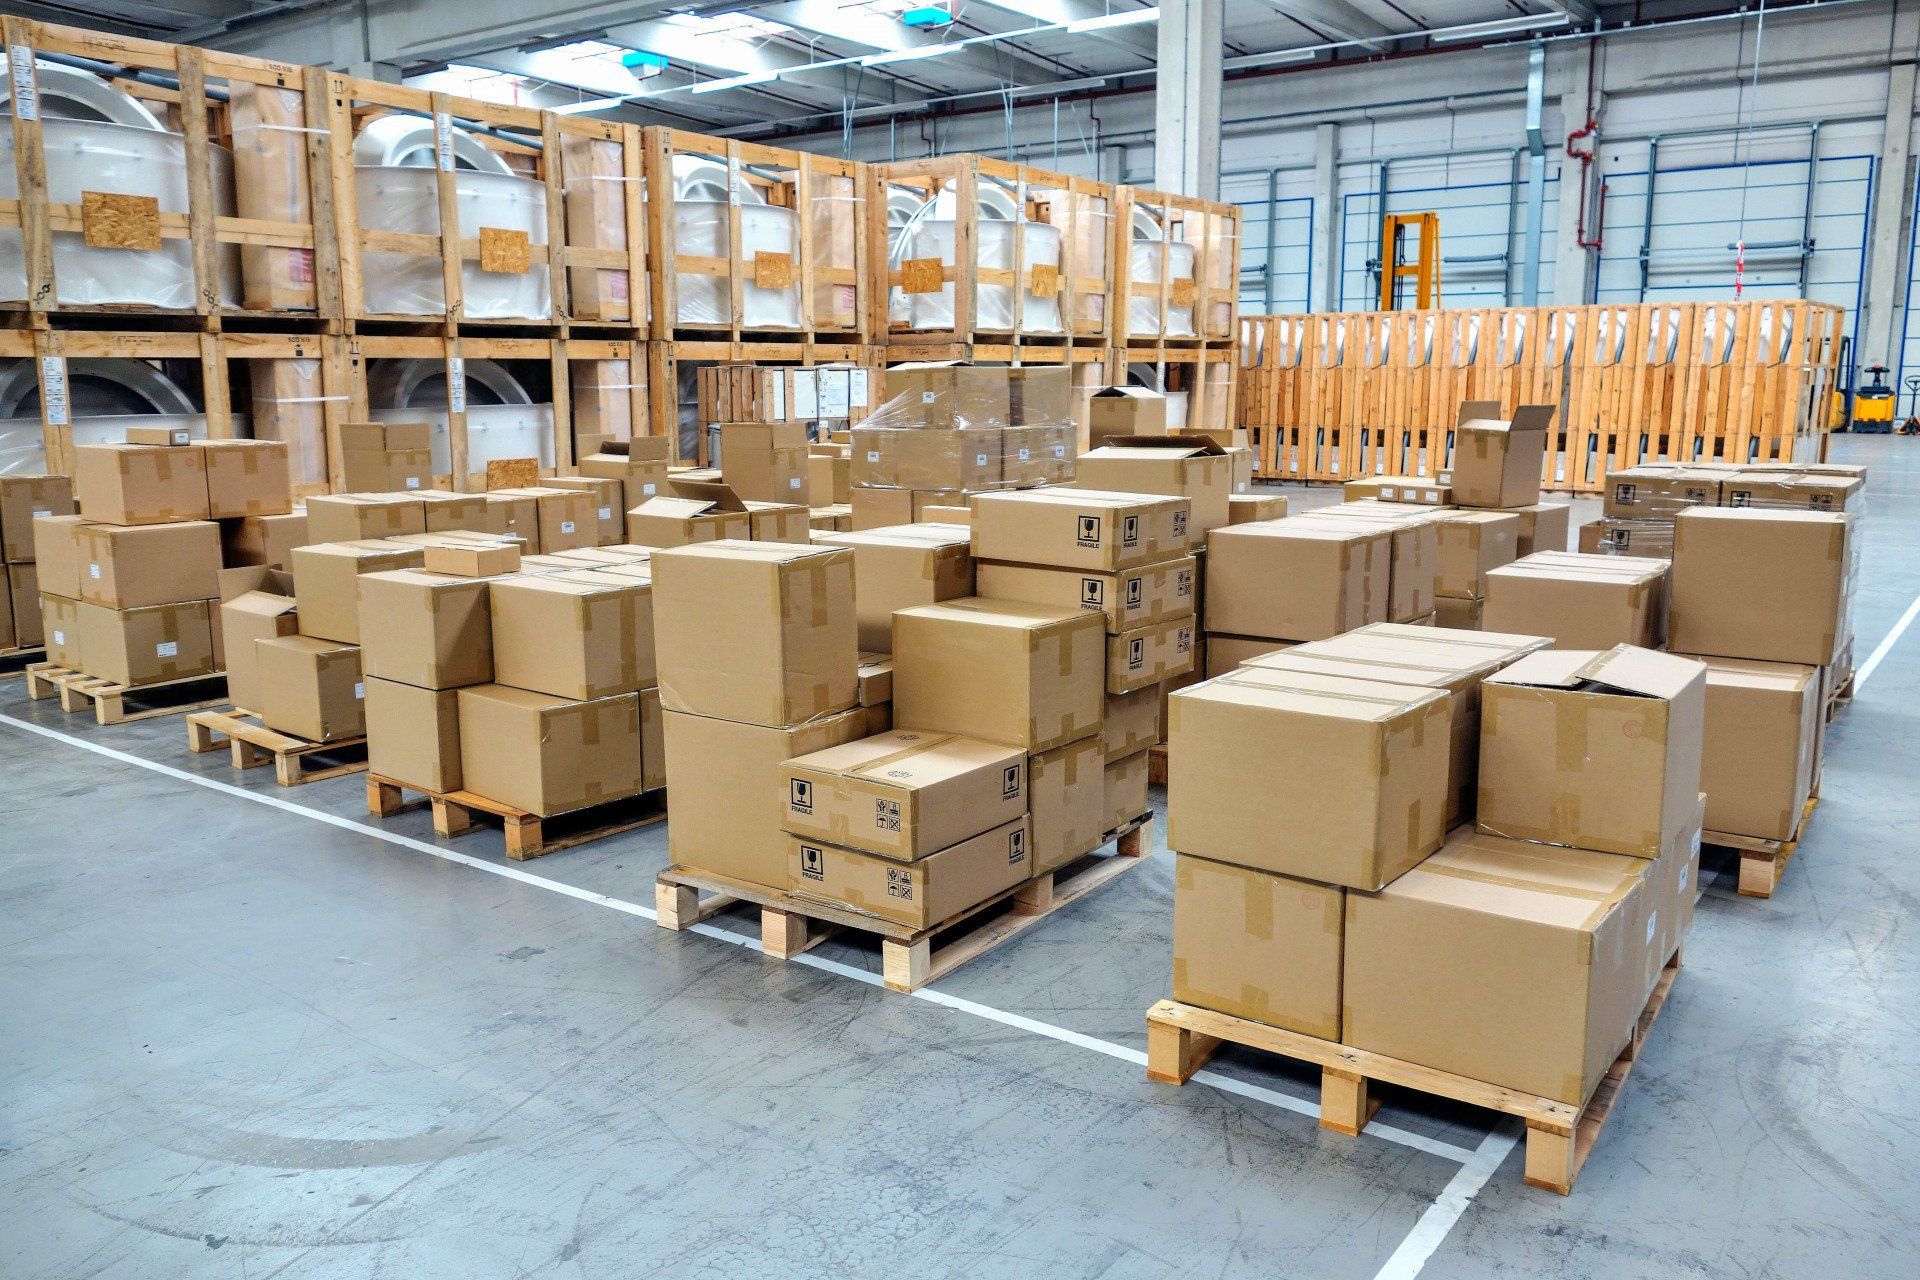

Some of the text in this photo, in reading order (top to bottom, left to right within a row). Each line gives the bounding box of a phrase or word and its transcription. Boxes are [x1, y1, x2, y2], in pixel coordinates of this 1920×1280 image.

[1077, 541, 1100, 549] FRAGILE
[1081, 603, 1103, 611] FRAGILE
[1002, 791, 1020, 802] FRAGILE
[791, 805, 813, 816] FRAGILE
[802, 871, 824, 882] FRAGILE
